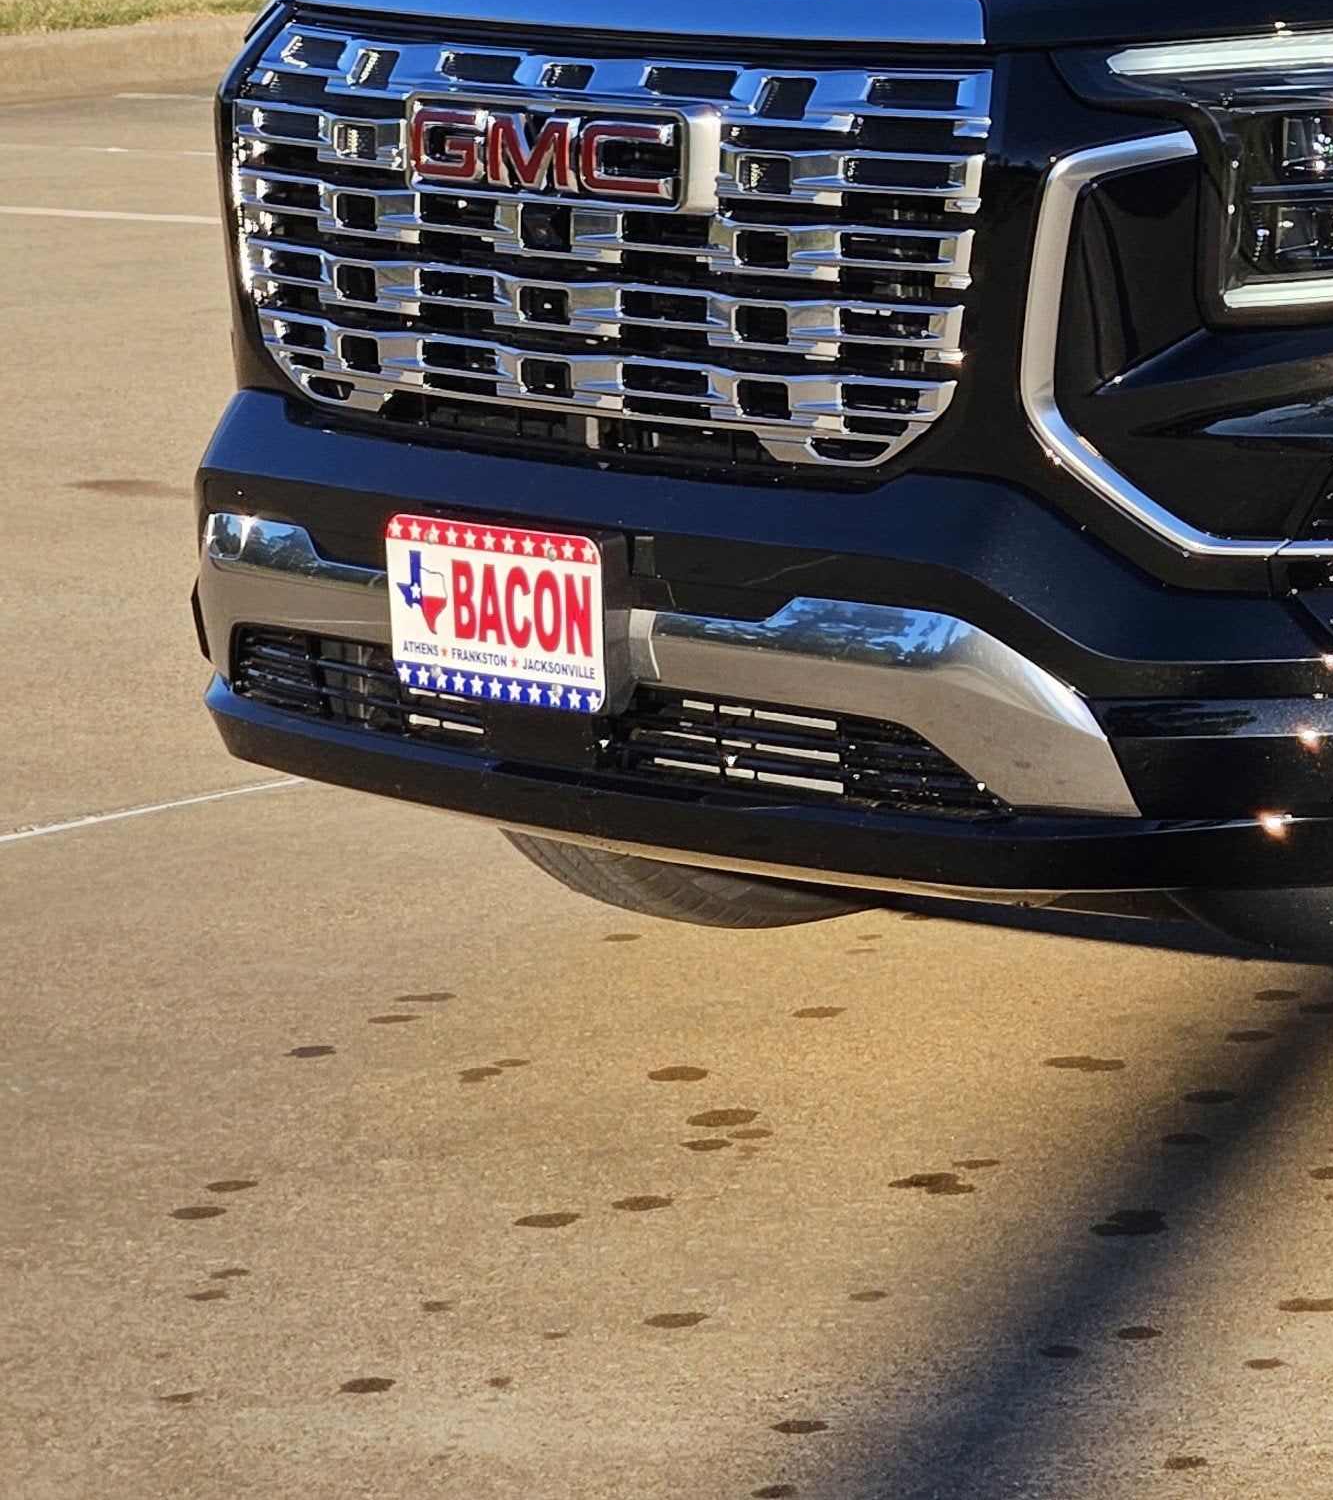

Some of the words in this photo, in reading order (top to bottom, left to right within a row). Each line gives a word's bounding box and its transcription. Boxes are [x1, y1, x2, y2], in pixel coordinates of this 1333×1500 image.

[411, 106, 674, 200] GMC
[451, 559, 593, 658] BACON
[403, 640, 439, 657] ATHENS
[451, 648, 508, 668] FRANKSTON
[521, 658, 597, 681] JACKSONVILLE
